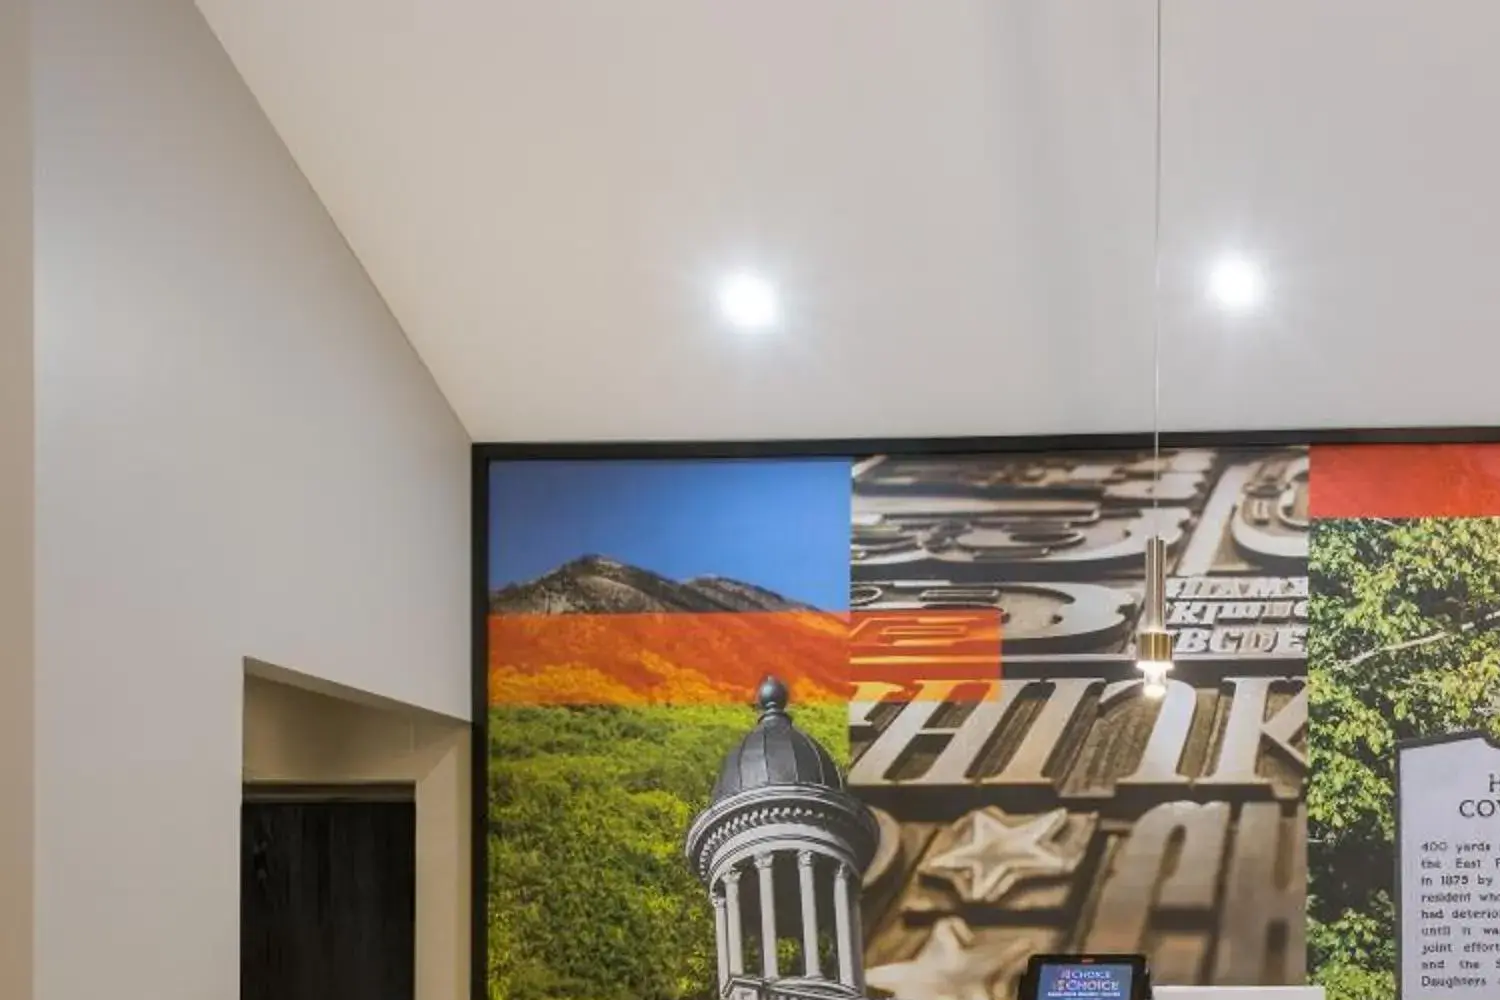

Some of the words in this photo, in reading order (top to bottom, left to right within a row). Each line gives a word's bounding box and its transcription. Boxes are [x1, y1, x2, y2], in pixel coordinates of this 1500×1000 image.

[1456, 841, 1490, 854] yards
[1421, 860, 1441, 869] the
[1456, 858, 1480, 868] East
[1478, 874, 1493, 886] by
[1422, 892, 1471, 903] resident
[1421, 909, 1444, 919] had
[1422, 926, 1451, 936] until
[1422, 943, 1452, 955] joint
[1422, 960, 1444, 969] and
[1459, 960, 1479, 969] the
[1066, 979, 1119, 991] CHOICE
[1422, 976, 1486, 988] Daughters
